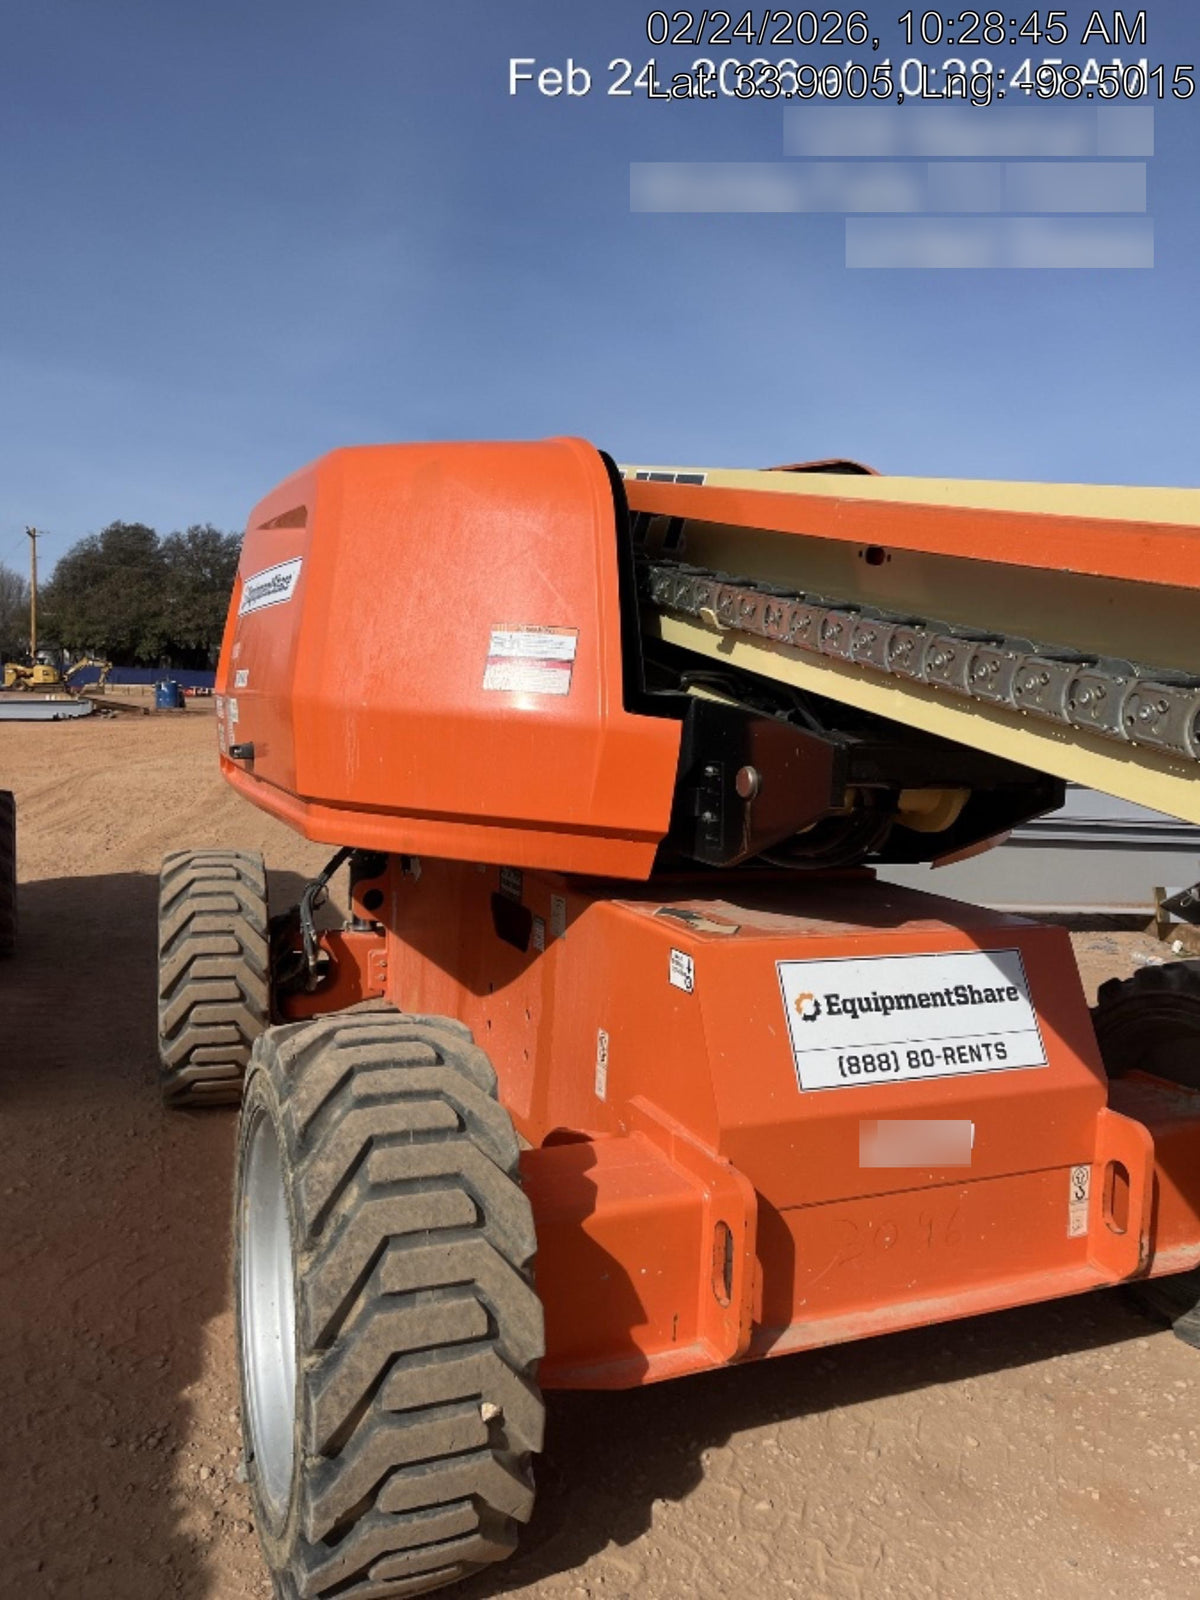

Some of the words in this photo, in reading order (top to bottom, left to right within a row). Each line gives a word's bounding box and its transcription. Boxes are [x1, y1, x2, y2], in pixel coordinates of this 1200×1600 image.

[824, 984, 1020, 1020] EquipmentShare
[838, 1051, 900, 1078] (888)
[907, 1042, 1008, 1070] 80-RENTS
